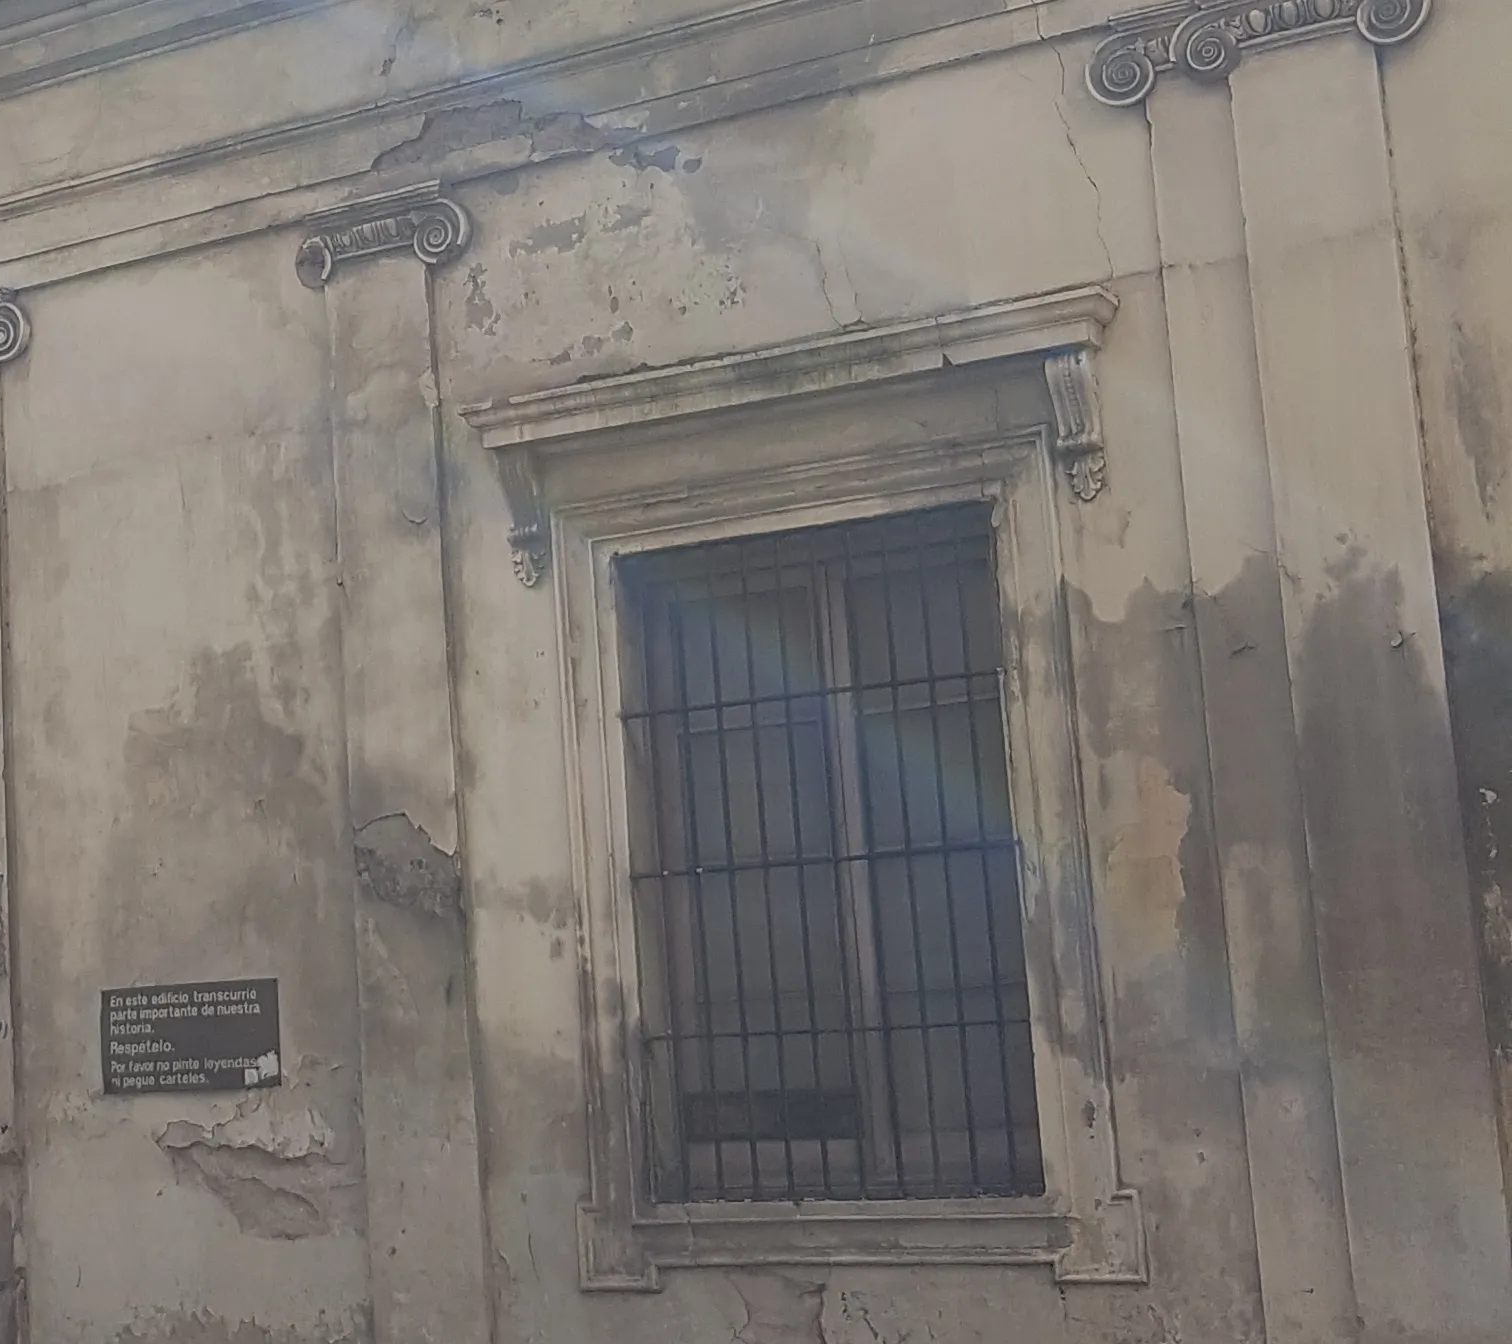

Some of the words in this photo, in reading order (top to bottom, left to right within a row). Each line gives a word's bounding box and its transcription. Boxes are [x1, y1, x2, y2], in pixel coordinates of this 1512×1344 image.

[110, 995, 124, 1008] En
[126, 993, 148, 1006] este
[151, 991, 189, 1005] edificio
[193, 988, 257, 1003] transcurrió
[110, 1008, 138, 1023] parte
[139, 1004, 198, 1020] importante
[201, 1004, 215, 1016] de
[217, 1001, 261, 1016] nuestra
[110, 1021, 155, 1036] historia.
[110, 1039, 175, 1056] Respételo.
[111, 1060, 126, 1073] Por
[128, 1060, 154, 1073] favor
[156, 1060, 170, 1072] no
[172, 1058, 199, 1073] pinte
[204, 1057, 257, 1073] leyendas
[123, 1075, 155, 1089] pegue
